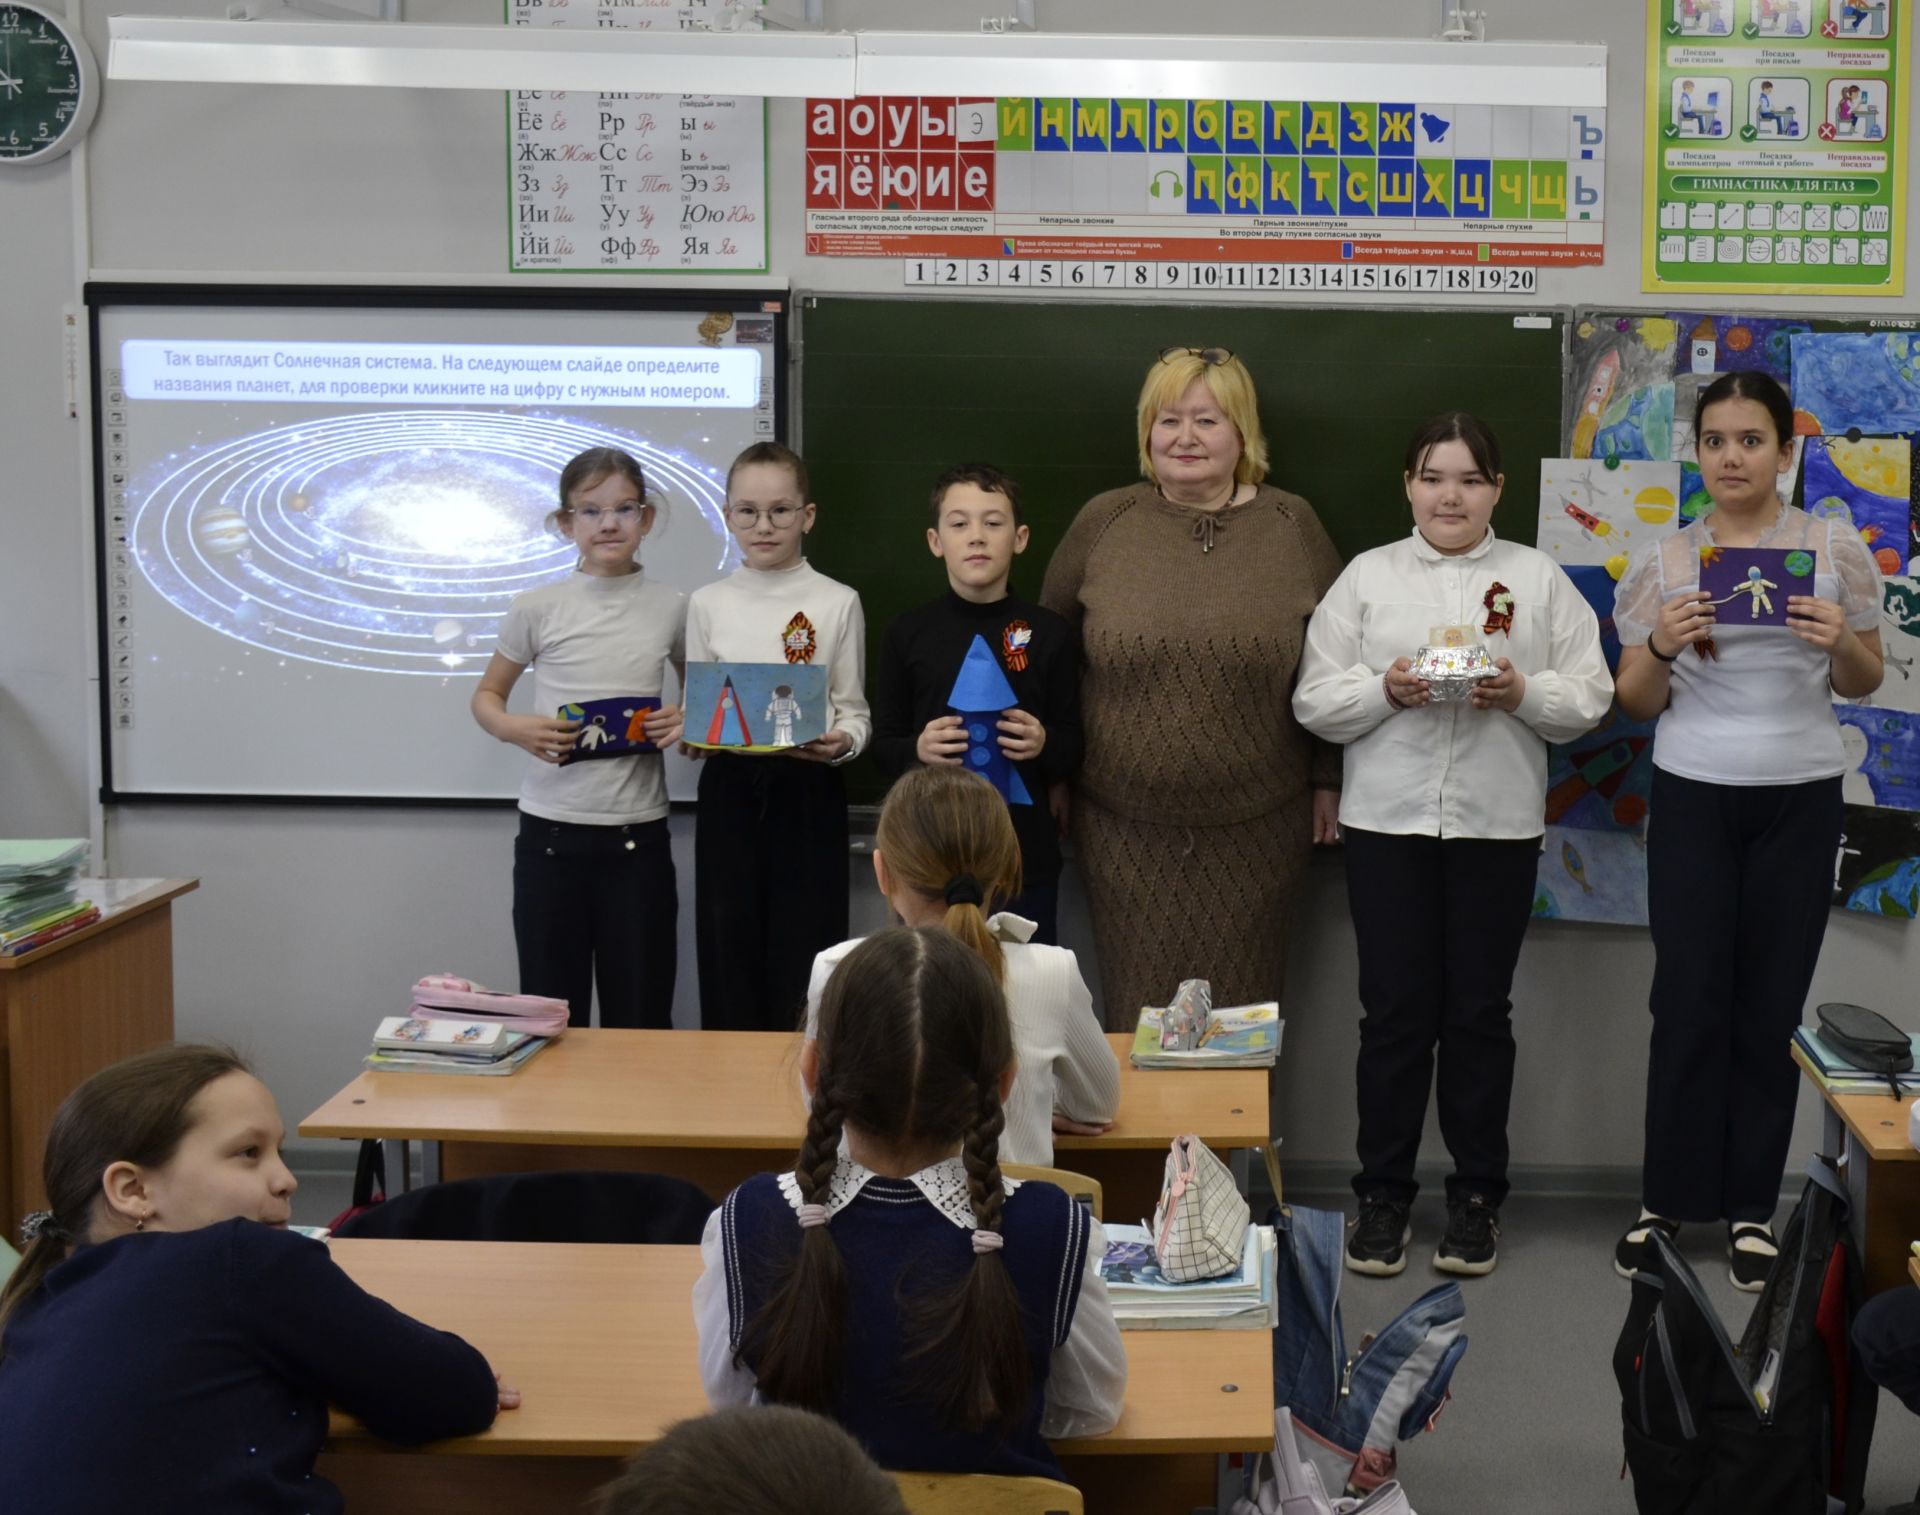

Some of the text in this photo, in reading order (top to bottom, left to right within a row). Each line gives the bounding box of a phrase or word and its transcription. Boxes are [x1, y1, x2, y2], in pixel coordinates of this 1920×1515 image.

[2, 13, 19, 27] 12
[38, 24, 48, 38] 1
[60, 45, 69, 59] 2
[1683, 48, 1716, 56] Посадка
[1762, 50, 1795, 58] Посадка
[1827, 51, 1885, 59] Неправильная
[69, 74, 77, 89] 3
[56, 107, 66, 122] 4
[517, 108, 543, 130] Ёё
[39, 122, 48, 137] 5
[599, 112, 625, 135] Рр
[812, 104, 955, 146] а о у ы
[1041, 107, 1064, 137] н
[1077, 107, 1105, 138] м
[1116, 108, 1142, 139] л
[1155, 108, 1179, 149] р
[1193, 100, 1218, 139] б
[1232, 109, 1256, 140] в
[1273, 110, 1290, 140] г
[1306, 111, 1335, 149] д
[1348, 111, 1370, 142] з
[1381, 111, 1413, 143] ж
[10, 130, 20, 145] 6
[517, 143, 557, 161] Жж
[599, 143, 627, 160] Сс
[1683, 152, 1716, 160] Посадка
[1759, 152, 1793, 160] Посадка
[1827, 153, 1885, 161] Неправильная
[518, 173, 540, 192] Зз
[600, 174, 627, 192] Тт
[681, 174, 708, 192] Ээ
[812, 155, 988, 198] я ё ю и е
[1193, 169, 1216, 200] п
[1226, 162, 1260, 208] ф
[1271, 170, 1291, 201] к
[1308, 171, 1331, 201] т
[1345, 171, 1369, 202] с
[1380, 173, 1412, 203] ш
[1422, 173, 1445, 203] х
[1460, 173, 1485, 212] ц
[1500, 174, 1521, 205] ч
[1531, 175, 1566, 213] щ
[1693, 179, 1855, 192] ГИМНАСТИКА ДЛЯ ГЛАЗ
[520, 204, 549, 222] Ии
[601, 204, 630, 227] Уу
[682, 204, 724, 222] Юю
[847, 215, 879, 223] второго
[881, 215, 900, 223] ряда
[1039, 216, 1080, 225] Непарные
[1254, 219, 1348, 229] Парные звонкие/глухие
[1463, 222, 1533, 232] Непарные глухие
[520, 232, 549, 254] Йй
[1285, 231, 1312, 239] глухие
[1359, 232, 1381, 240] звуки
[601, 237, 636, 260] Фф
[682, 237, 709, 254] Яя
[1355, 246, 1382, 255] Всегда
[1385, 247, 1419, 256] твёрдые
[1421, 248, 1444, 256] звуки
[1492, 249, 1519, 257] Всегда
[915, 263, 1533, 289] 1 2 3 4 5 6 7 8 9 10 11 12 13 14 15 16 17 18 19 20
[164, 350, 720, 375] Так выглядит Солнечная система. На следующем слайде определите
[154, 378, 731, 402] названия планет, для проверки кликните на цифру с нужным номером.
